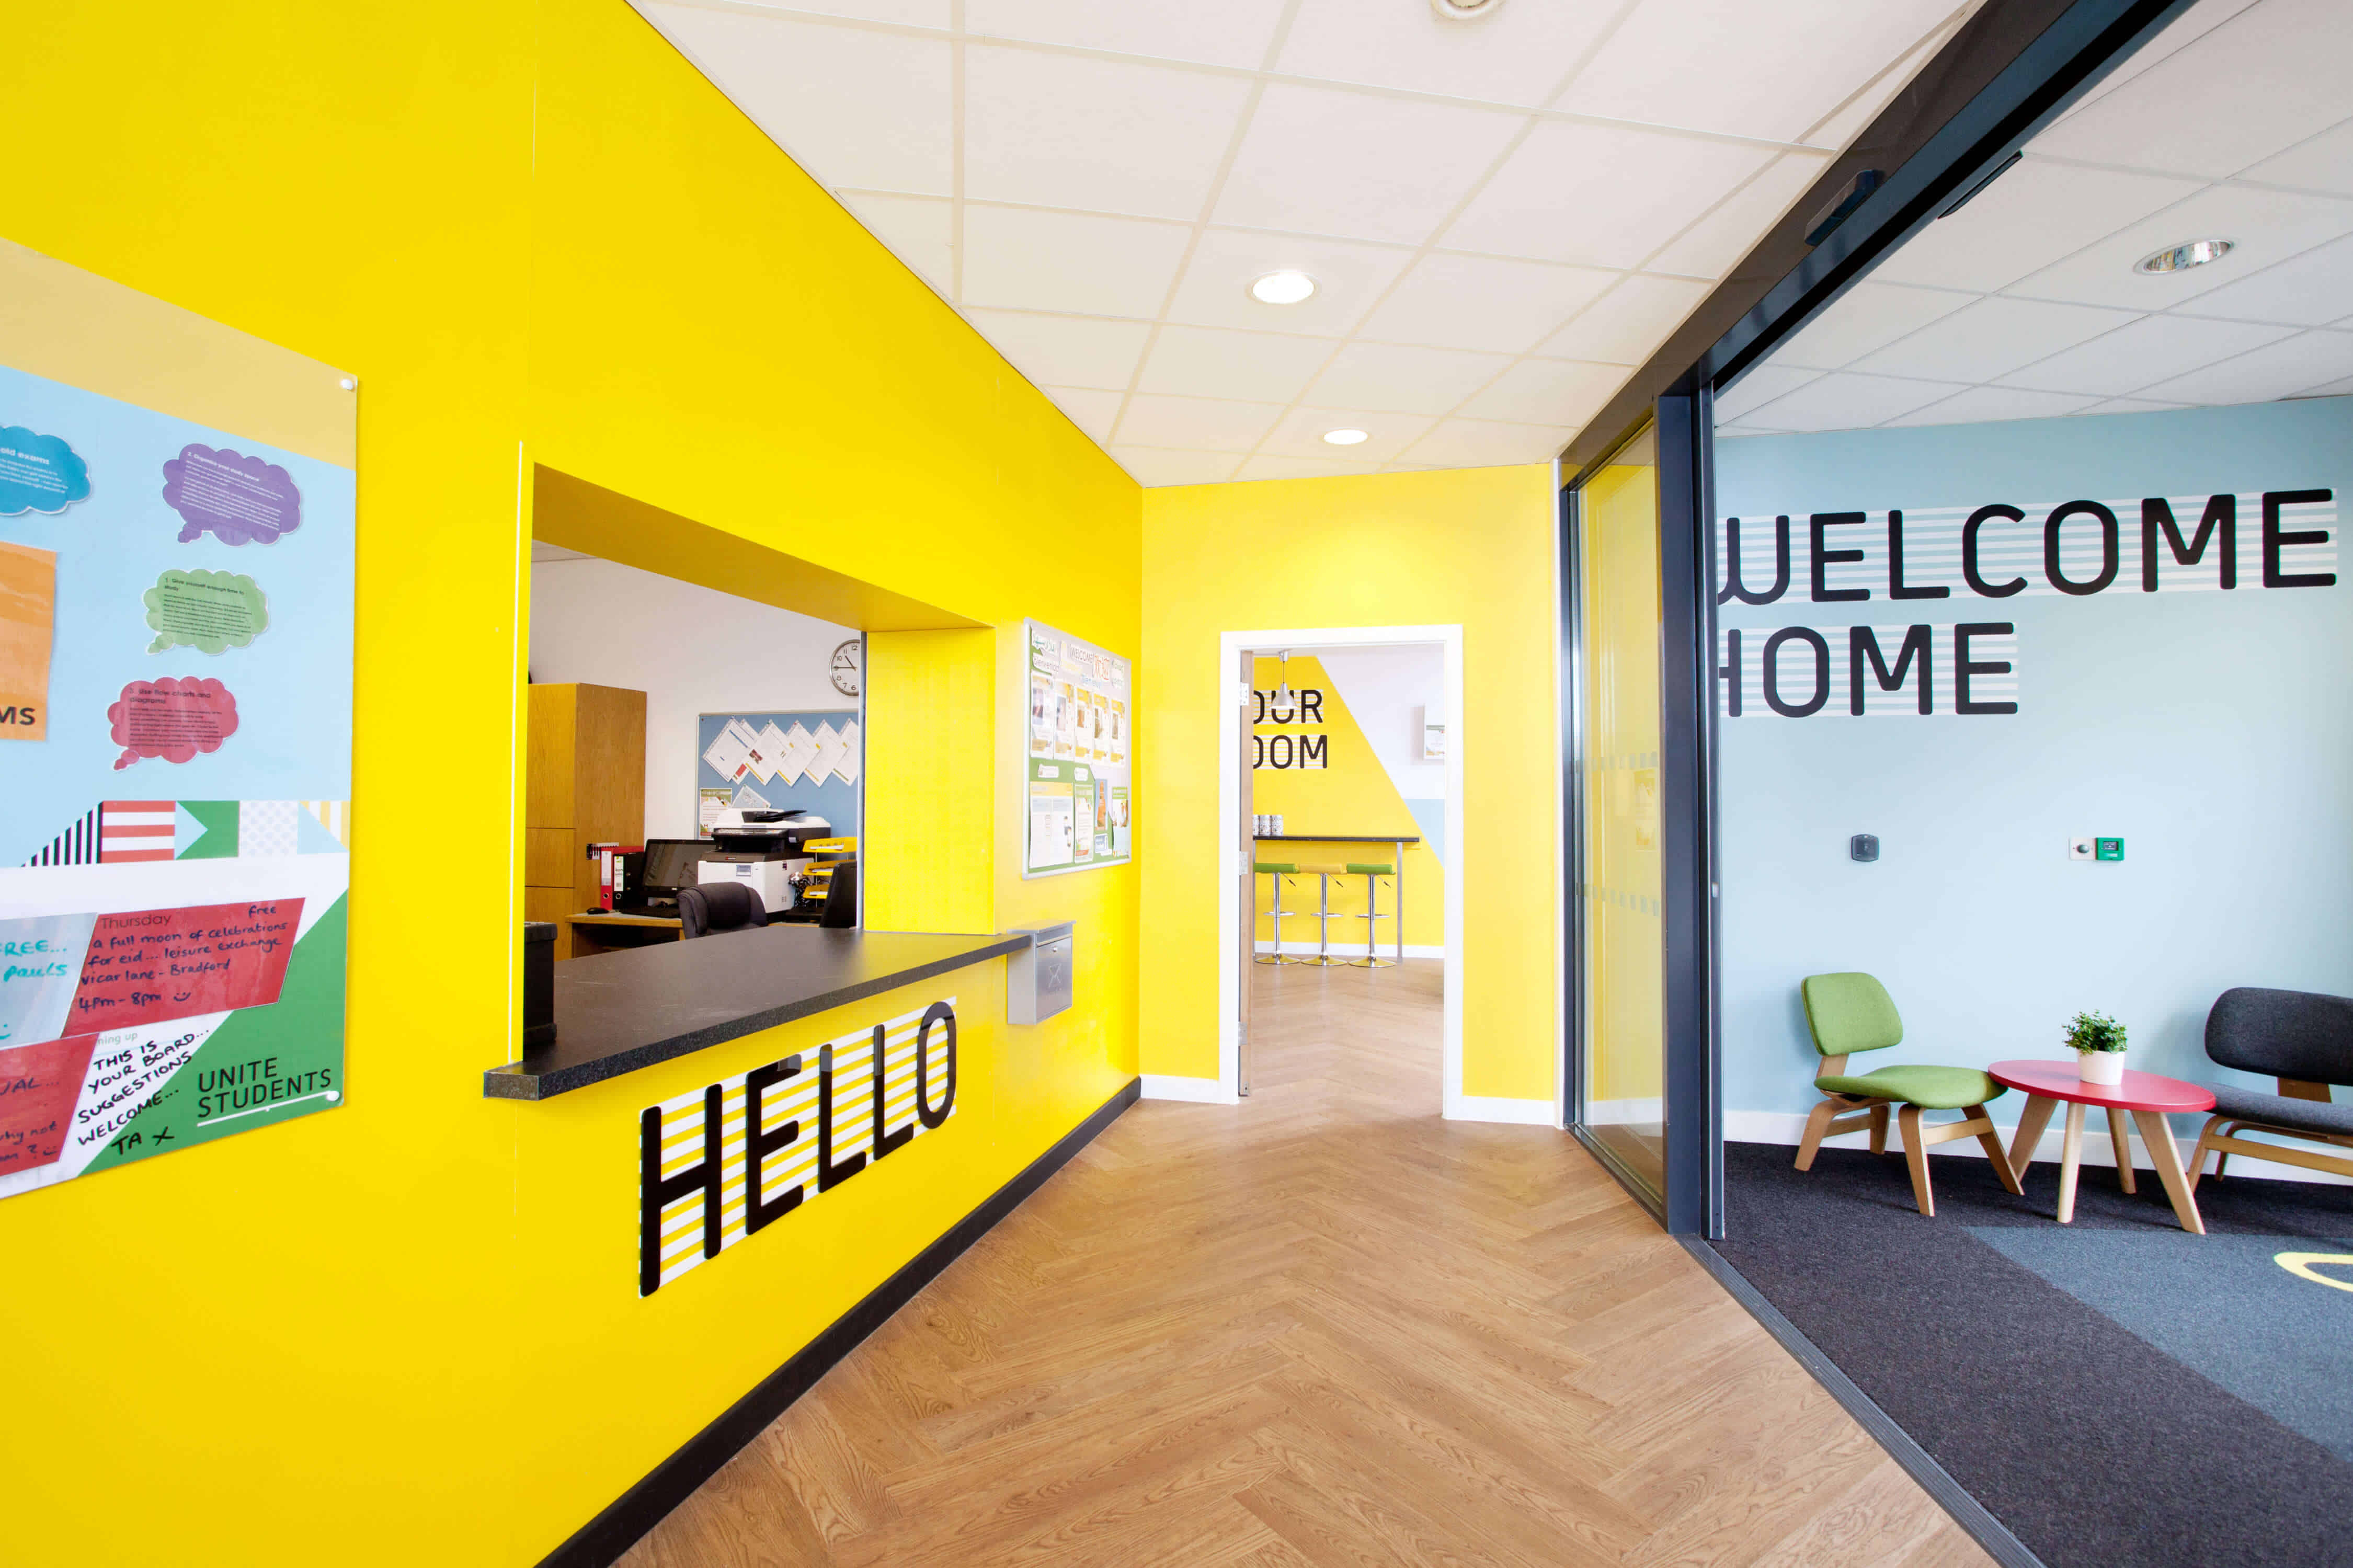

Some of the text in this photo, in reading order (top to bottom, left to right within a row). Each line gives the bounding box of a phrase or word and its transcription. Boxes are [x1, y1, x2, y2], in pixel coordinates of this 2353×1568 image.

[1718, 489, 2336, 605] WELCOME
[101, 914, 172, 929] Thursday
[248, 905, 277, 918] free
[0, 940, 67, 957] REE...
[93, 922, 288, 950] a full moon of celebrations
[88, 955, 115, 967] for
[164, 945, 211, 959] leisure
[218, 938, 283, 953] exchange
[125, 970, 155, 981] lane
[170, 958, 231, 976] Bradford
[131, 992, 162, 1007] 8pm
[124, 1032, 138, 1043] up
[93, 1040, 157, 1071] THIS IS
[78, 1051, 192, 1124] SUGGESTIONS
[87, 1065, 137, 1094] YOUR
[199, 1057, 277, 1093] UNITE
[197, 1068, 332, 1118] STUDENTS
[110, 1132, 143, 1155] TA
[641, 1001, 956, 1297] HELLO
